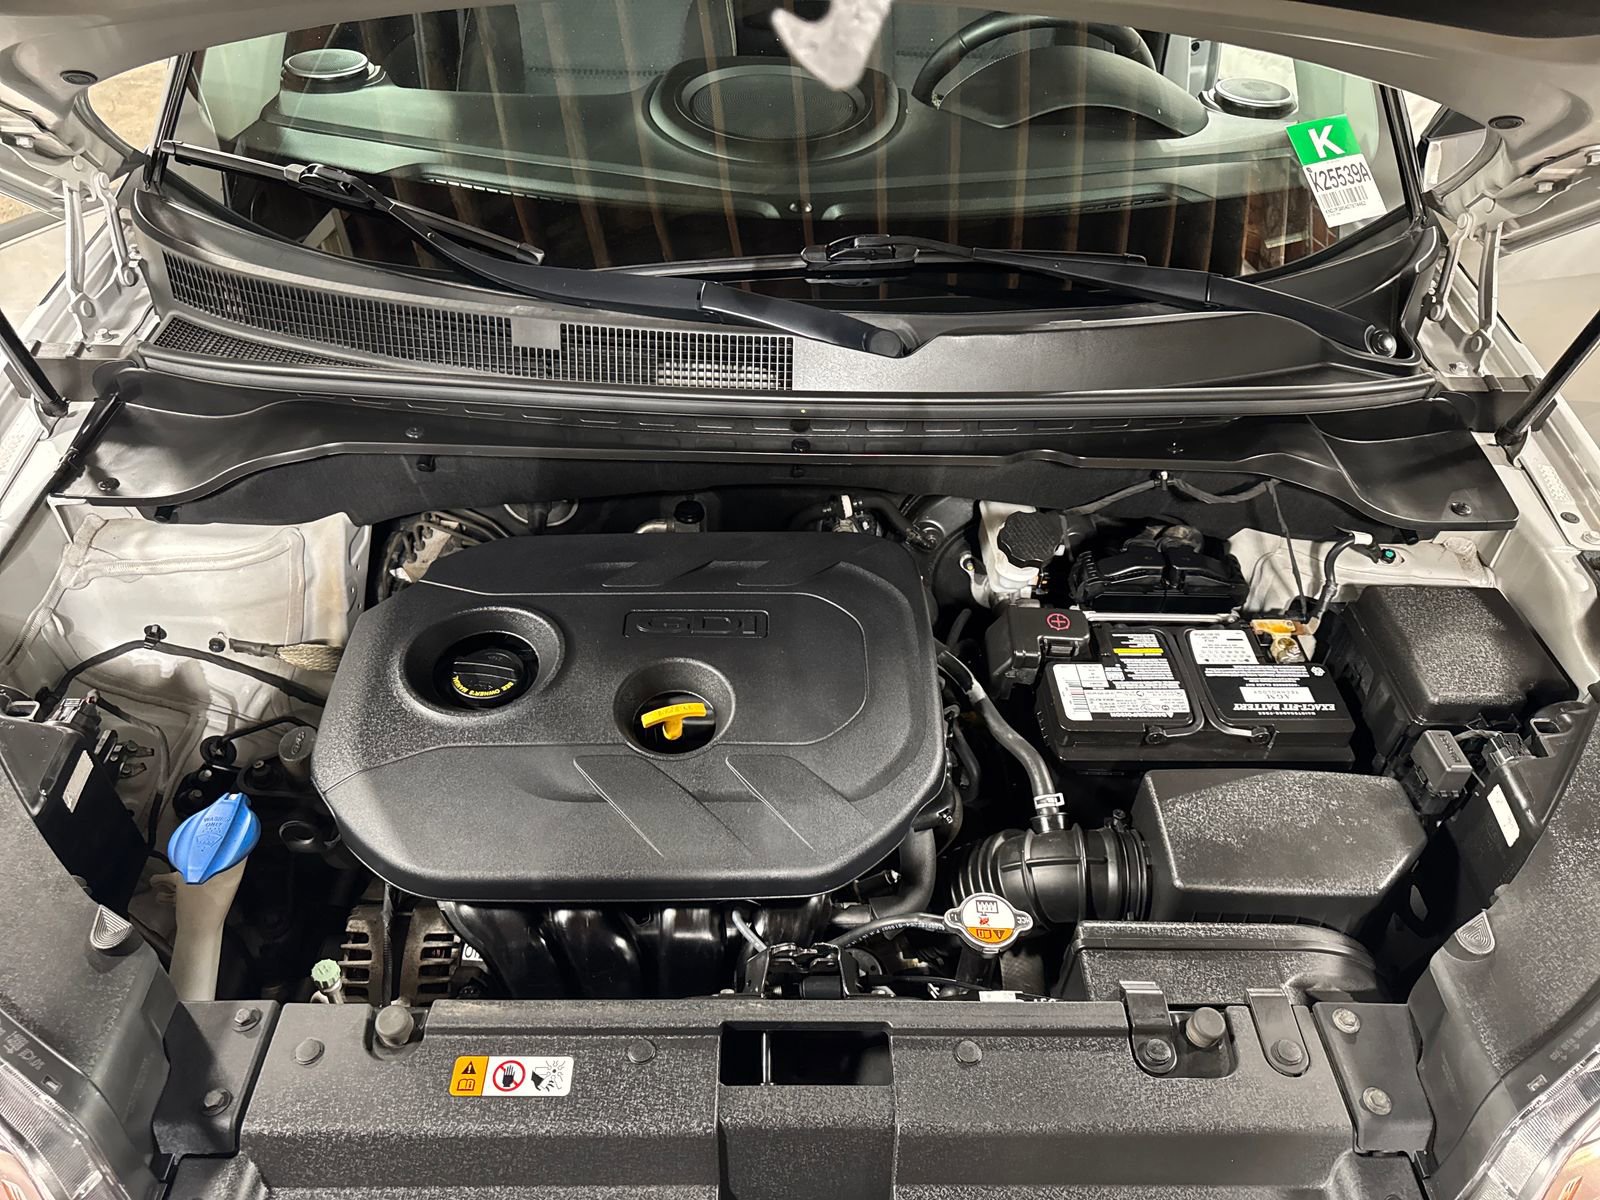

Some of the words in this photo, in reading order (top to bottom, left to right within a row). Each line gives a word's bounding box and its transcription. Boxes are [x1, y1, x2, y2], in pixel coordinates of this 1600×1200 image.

[1308, 125, 1346, 159] K
[1309, 162, 1372, 193] K25539A
[1233, 703, 1281, 711] BATTERY
[1281, 703, 1336, 711] EXACT-FIT
